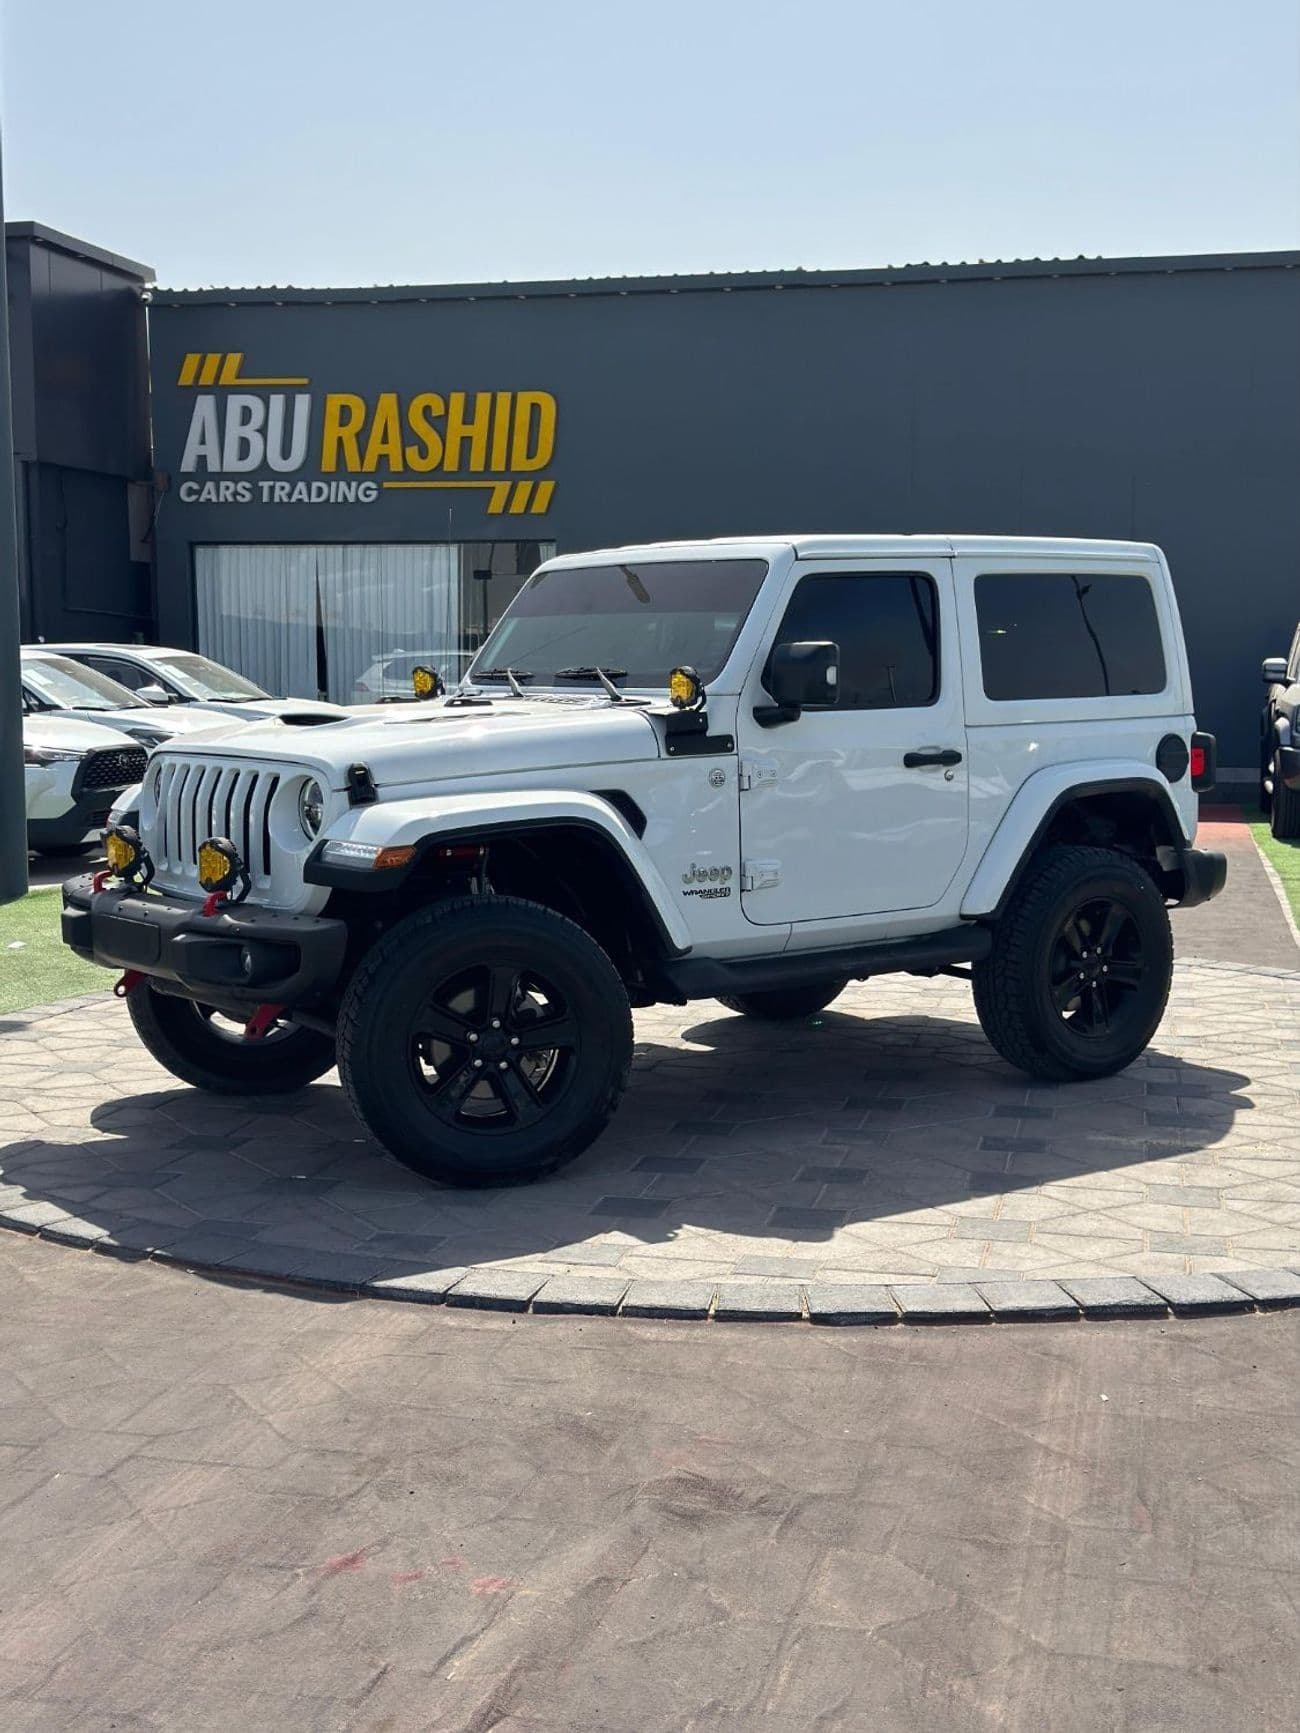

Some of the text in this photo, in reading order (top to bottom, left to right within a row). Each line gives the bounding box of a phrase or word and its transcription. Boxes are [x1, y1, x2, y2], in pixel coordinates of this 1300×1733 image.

[180, 391, 557, 473] ABU RASHID
[179, 481, 379, 503] CARS TRADING
[682, 862, 732, 885] Jeep
